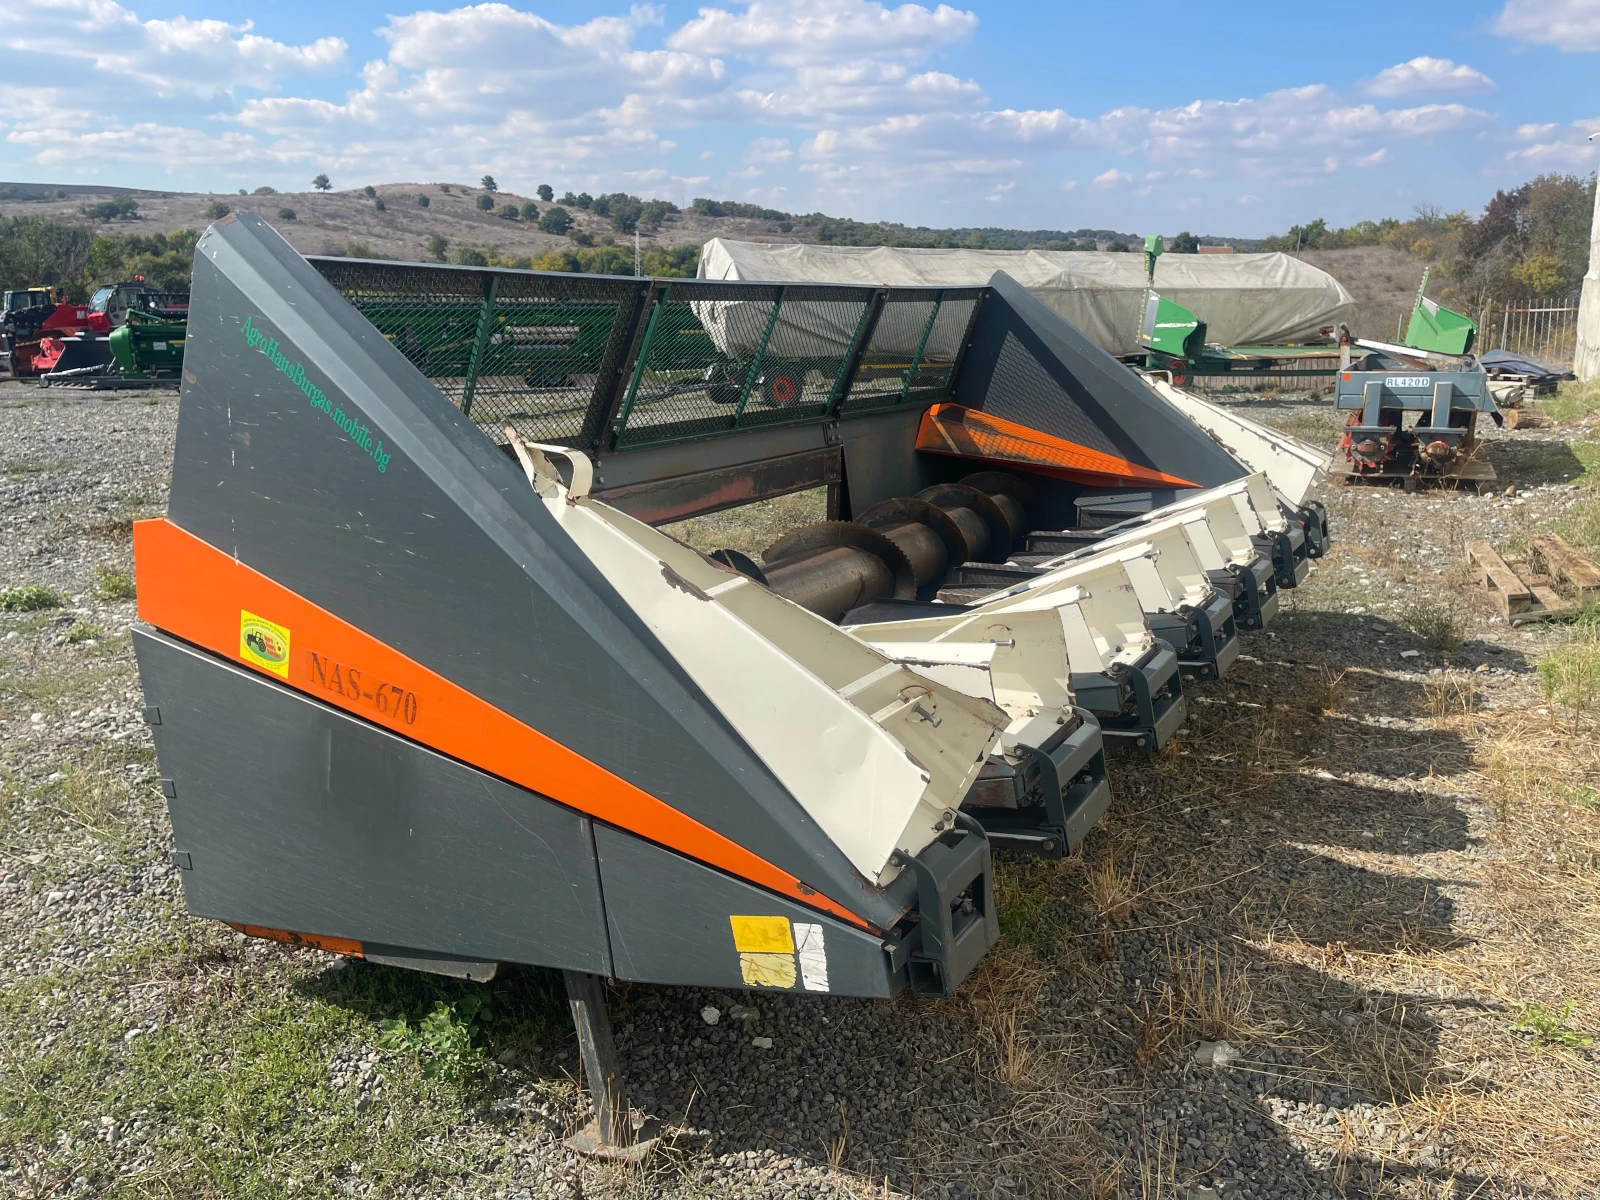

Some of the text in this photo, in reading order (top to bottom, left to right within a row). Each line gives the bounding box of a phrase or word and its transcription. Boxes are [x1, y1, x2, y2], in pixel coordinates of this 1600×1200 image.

[241, 317, 391, 473] AgroHausBurgas.mobile.bg
[1387, 378, 1429, 386] RL420D
[311, 653, 417, 724] NAS-670
